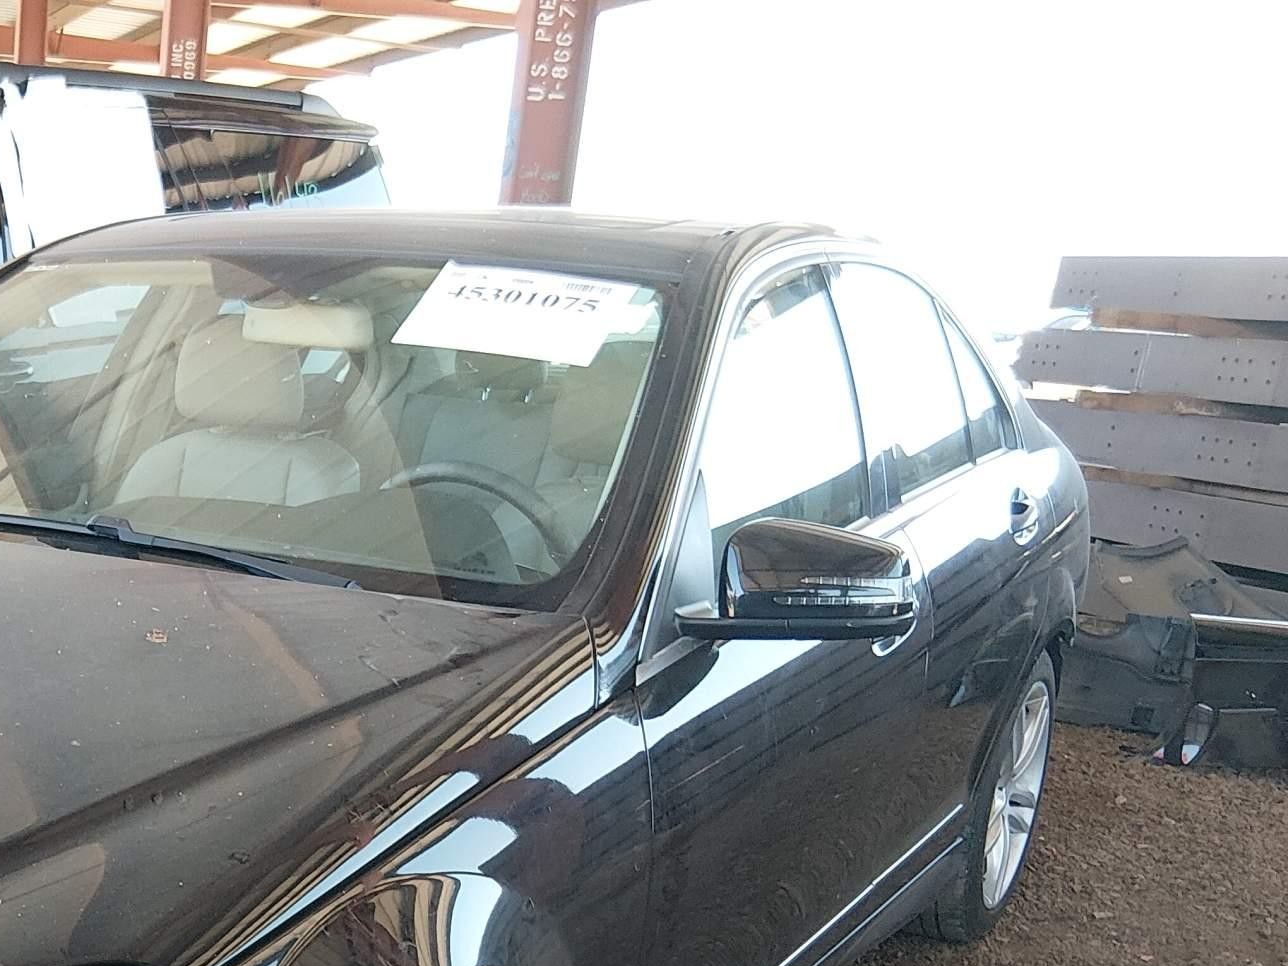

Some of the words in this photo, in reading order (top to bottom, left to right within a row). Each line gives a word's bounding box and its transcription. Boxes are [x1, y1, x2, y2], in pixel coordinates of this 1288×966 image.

[170, 40, 184, 67] INC.
[548, 0, 576, 100] 1-866-7
[526, 58, 550, 101] U.S.
[448, 285, 600, 312] 45301075
